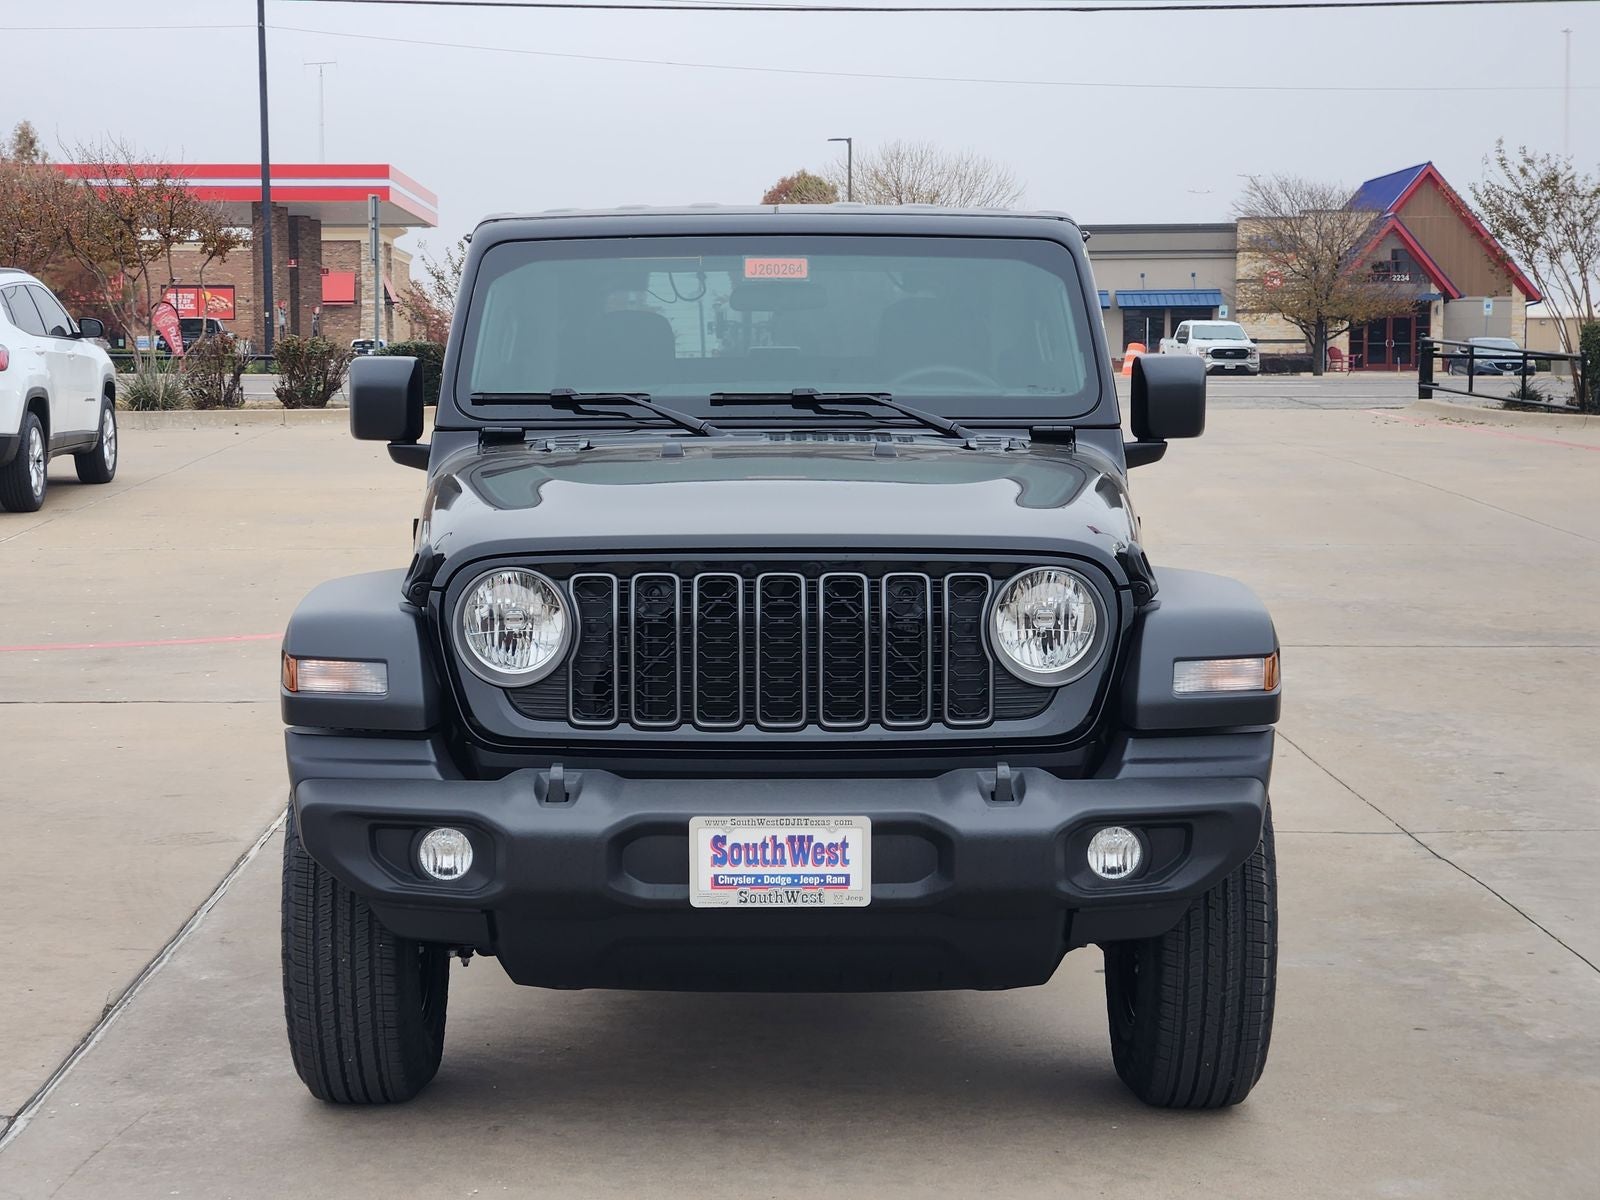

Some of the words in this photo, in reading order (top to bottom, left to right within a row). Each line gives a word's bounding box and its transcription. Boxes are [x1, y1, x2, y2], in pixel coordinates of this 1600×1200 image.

[750, 263, 803, 276] J260264
[1392, 274, 1410, 282] 2234
[710, 834, 850, 868] SouthWest
[718, 875, 756, 886] Chrysler
[763, 875, 792, 885] Dodge
[799, 875, 820, 885] Jeep
[826, 875, 846, 884] Ram
[738, 890, 825, 904] SouthWest
